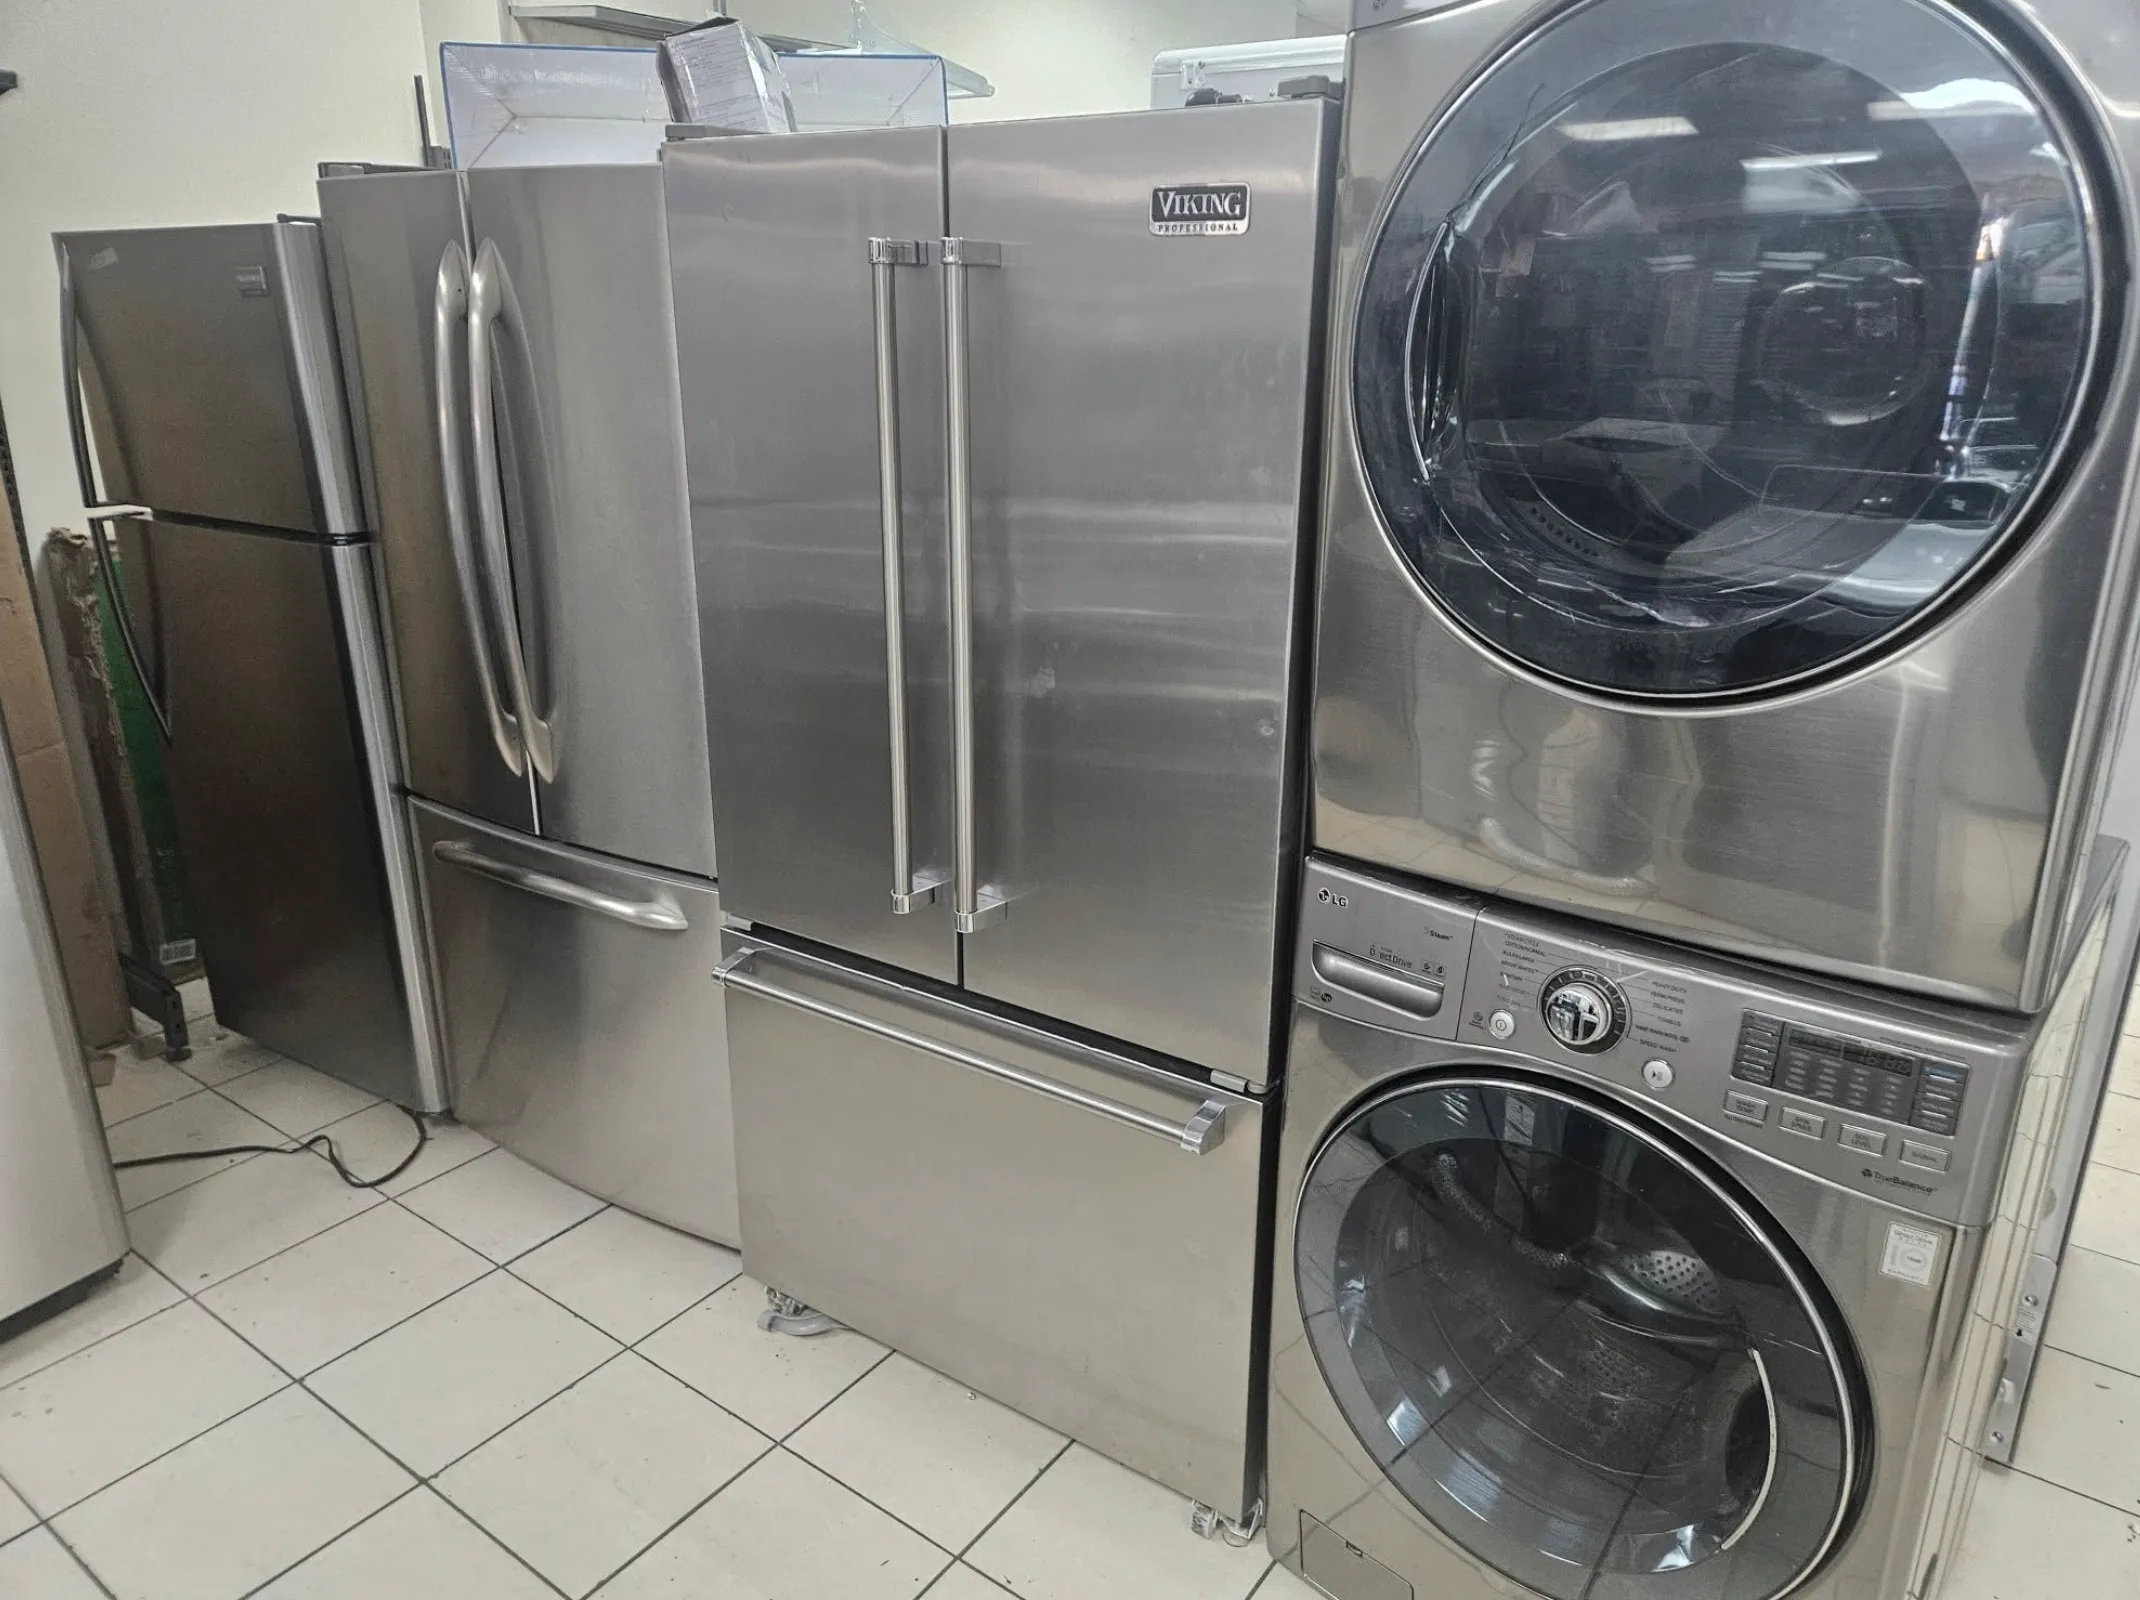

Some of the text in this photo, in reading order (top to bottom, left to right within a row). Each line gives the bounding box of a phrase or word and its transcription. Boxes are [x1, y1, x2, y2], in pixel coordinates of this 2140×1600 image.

[1157, 190, 1242, 219] VIKING
[1158, 223, 1239, 234] PROFESSIONAL
[1331, 893, 1348, 908] LG
